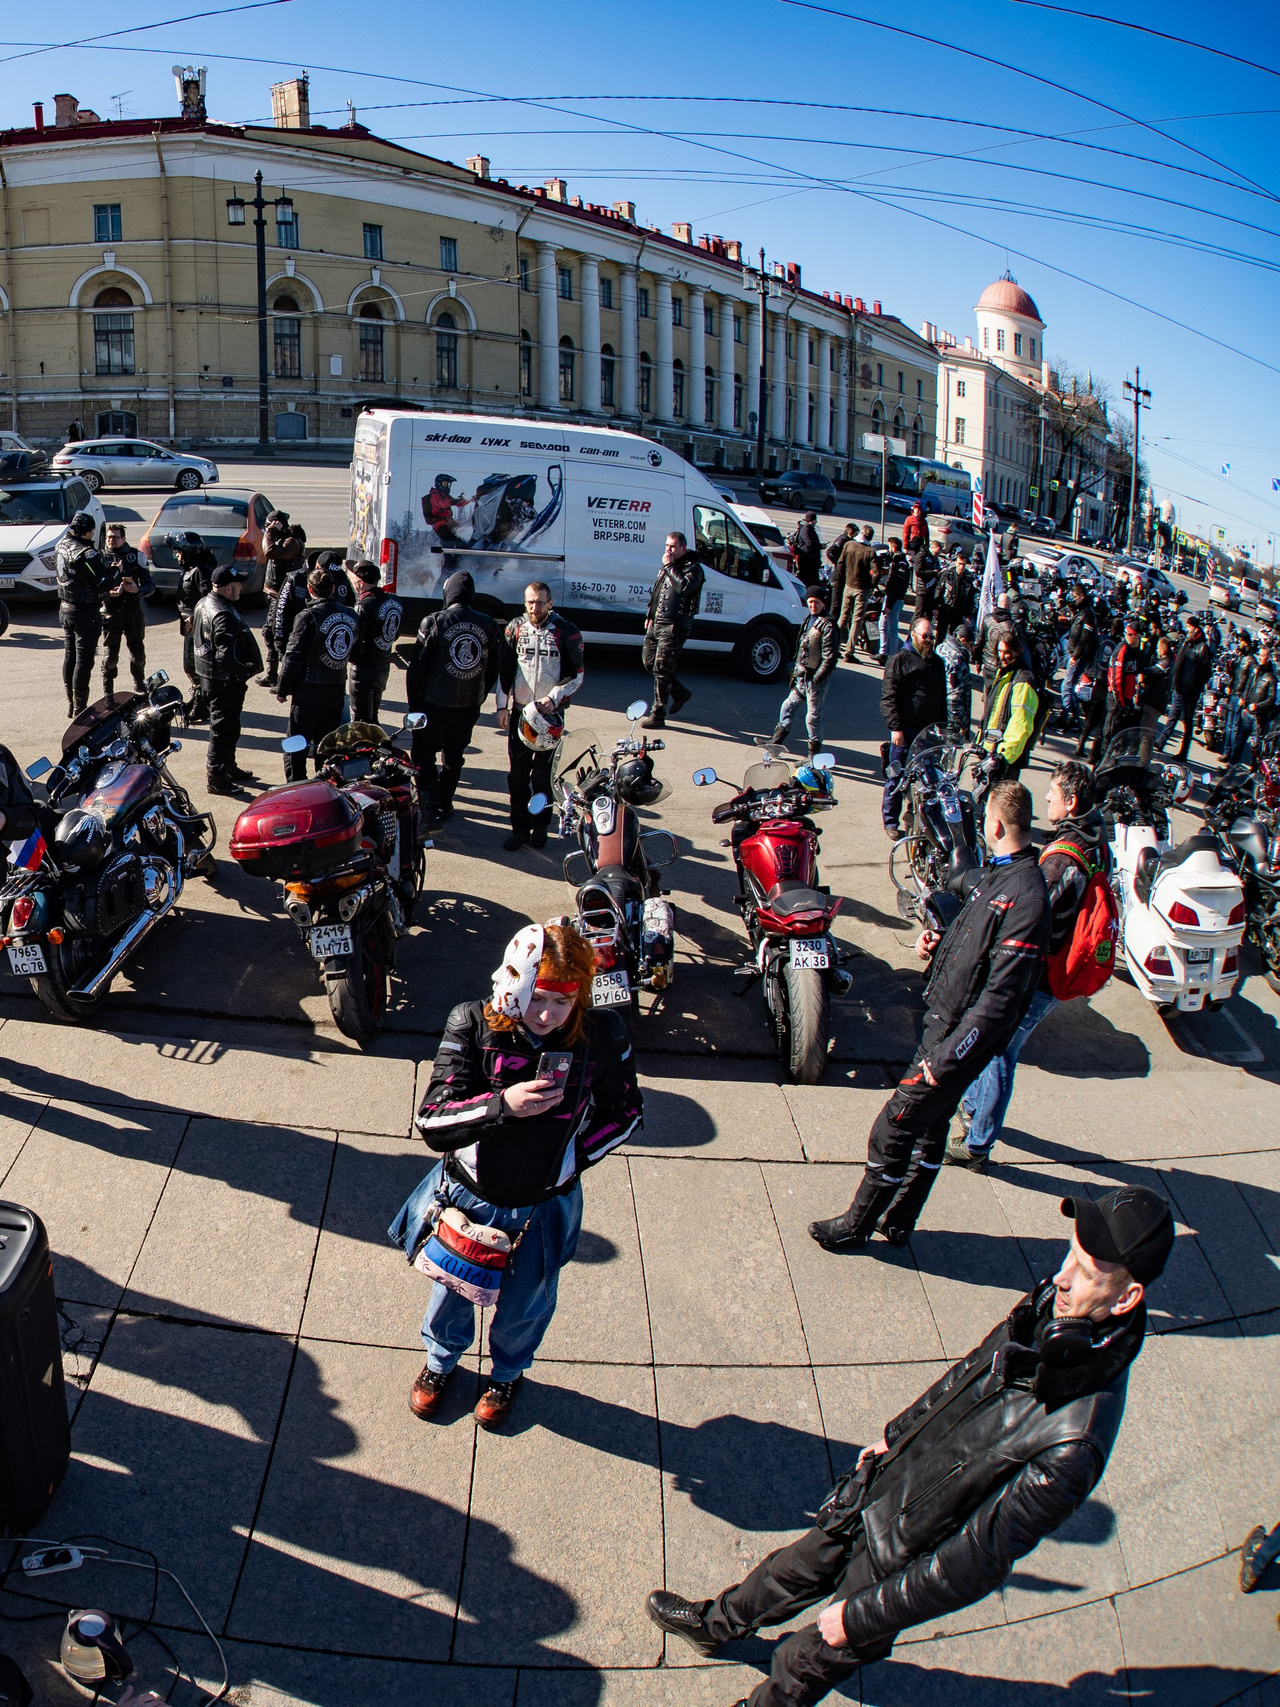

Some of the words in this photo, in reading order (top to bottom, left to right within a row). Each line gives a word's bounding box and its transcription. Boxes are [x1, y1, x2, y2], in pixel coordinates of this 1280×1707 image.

[480, 437, 512, 447] LYNX
[587, 496, 652, 513] VETERR
[592, 518, 647, 531] VETERR.COM
[593, 531, 645, 544] BRP.SPB.RU
[570, 582, 616, 593] 336-70-70
[628, 585, 653, 595] 702-4
[316, 926, 344, 938] 2419
[335, 942, 350, 953] 78
[796, 940, 822, 951] 3230
[11, 946, 37, 958] 7965
[1201, 950, 1209, 959] 78
[30, 961, 44, 972] 78
[813, 956, 826, 966] 38
[595, 973, 622, 987] 8568
[614, 989, 628, 1001] 60
[956, 1028, 978, 1058] MCP
